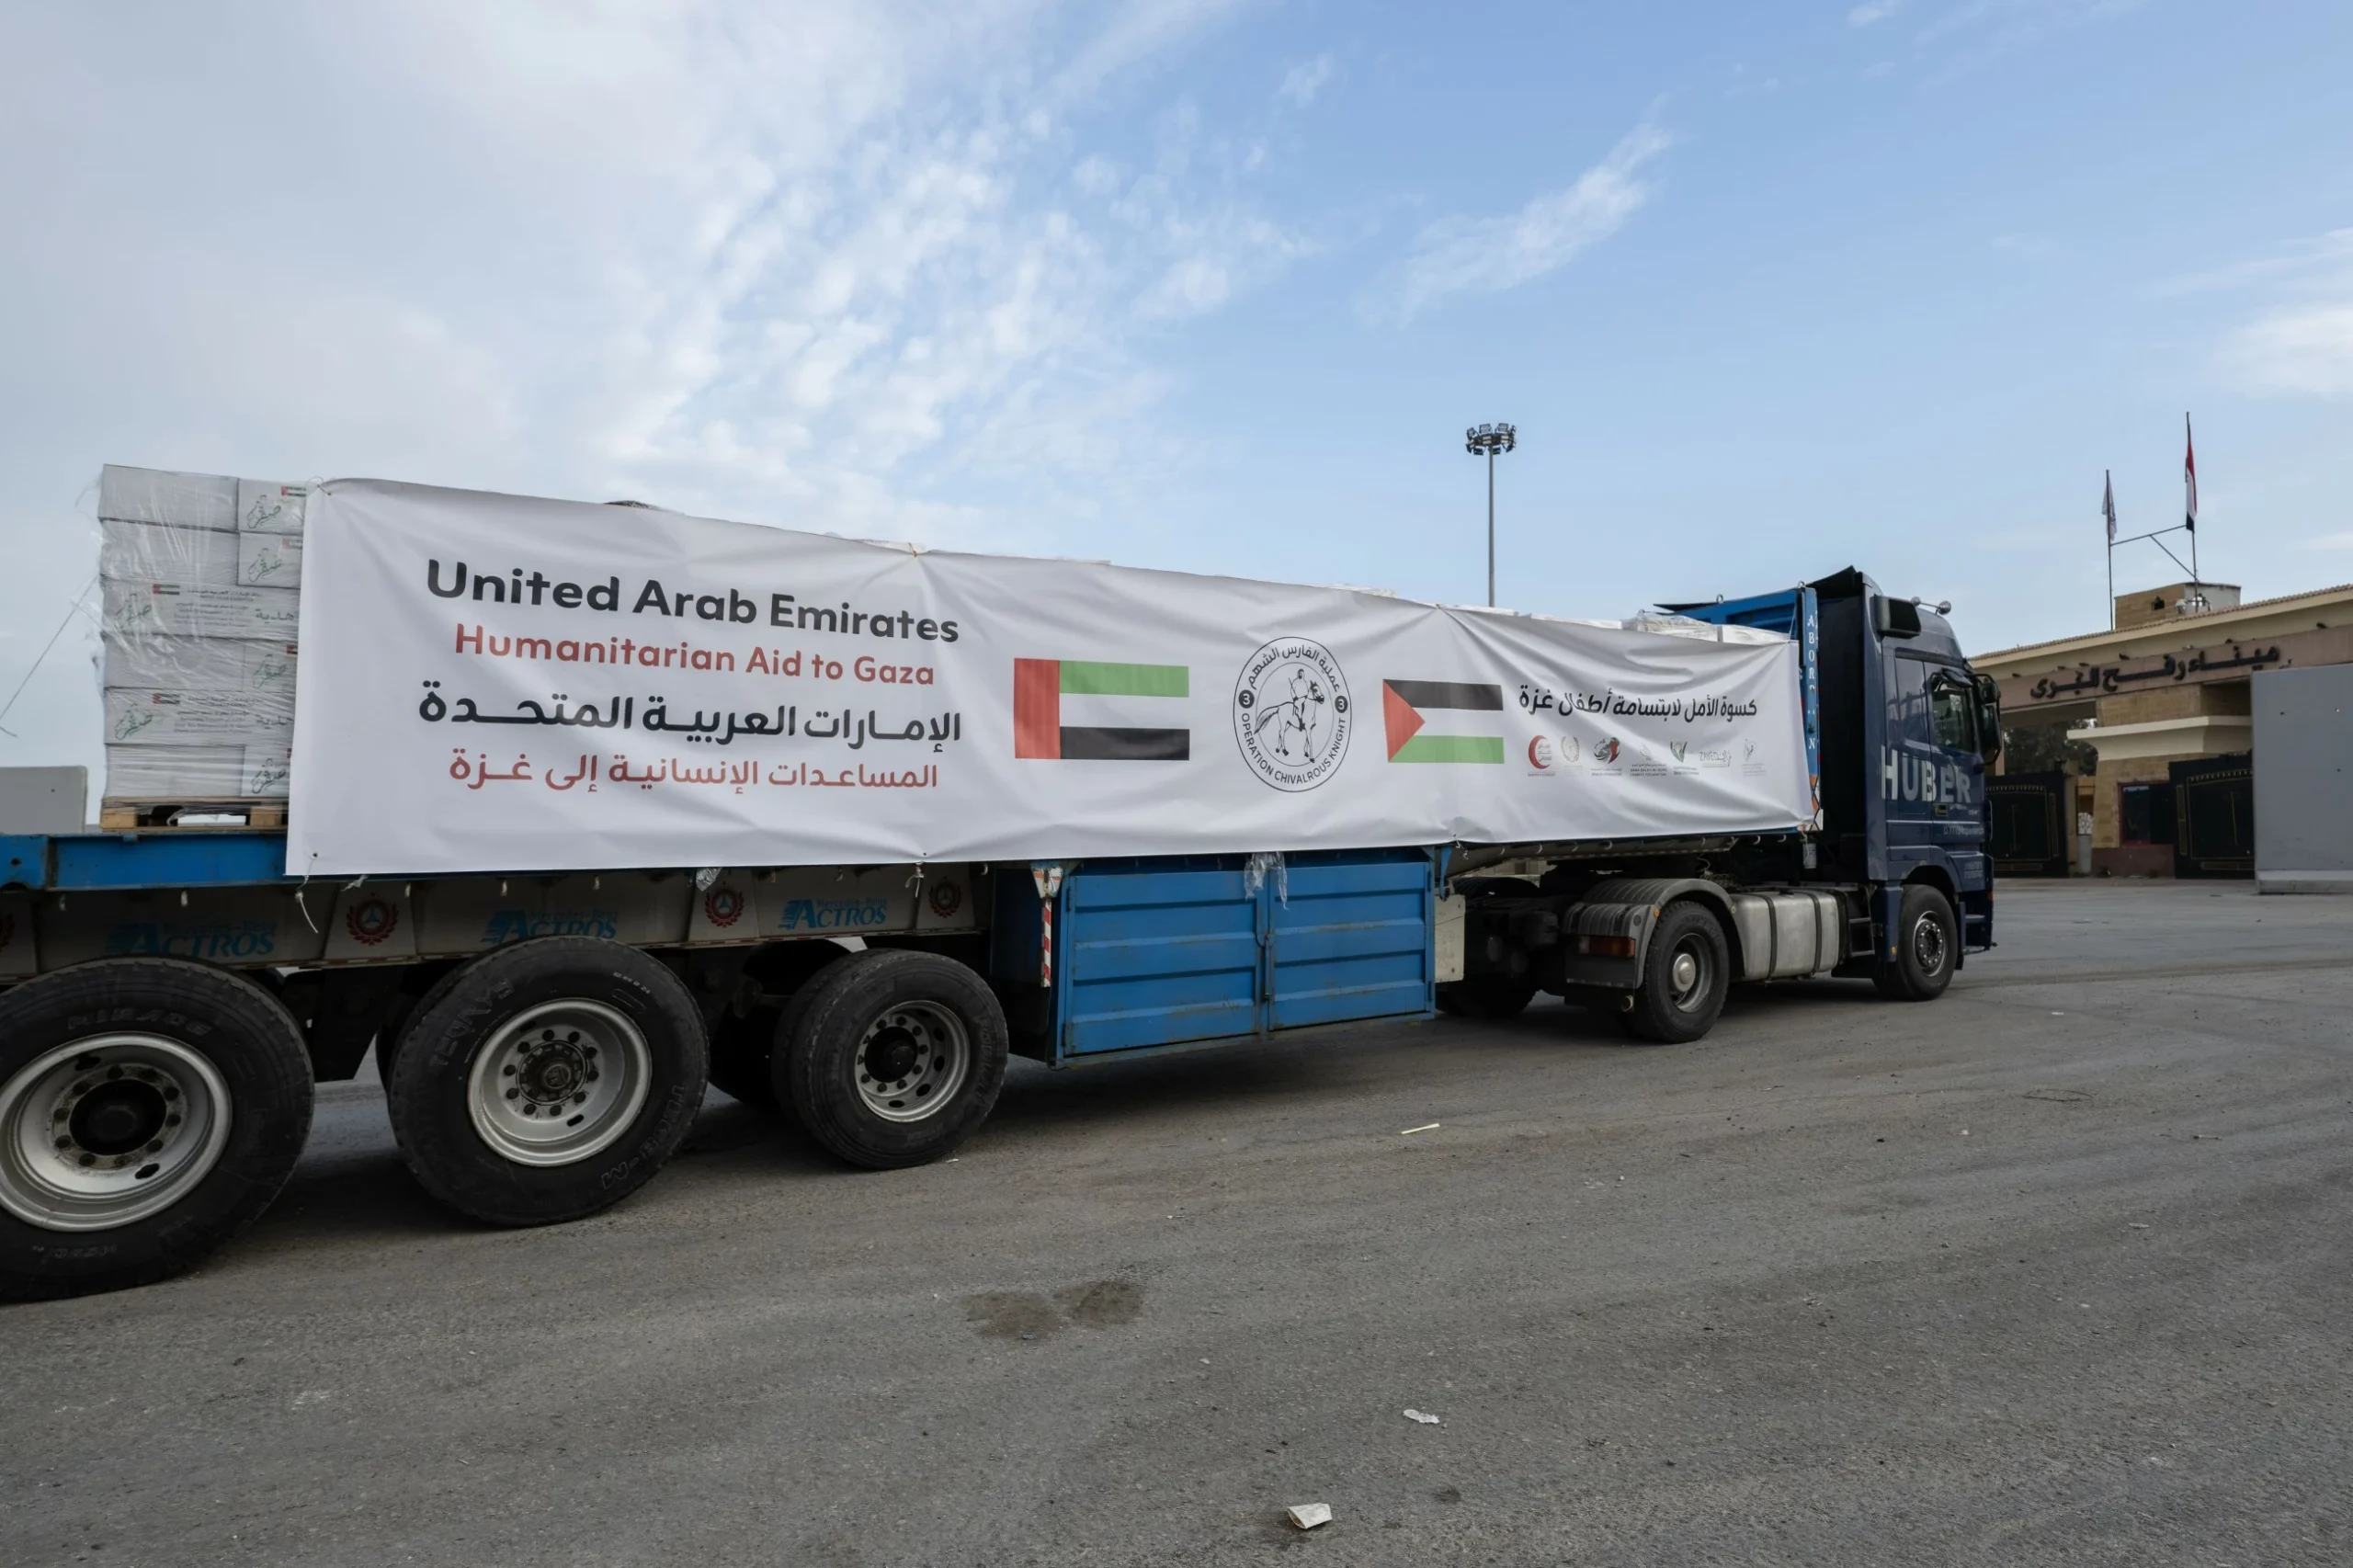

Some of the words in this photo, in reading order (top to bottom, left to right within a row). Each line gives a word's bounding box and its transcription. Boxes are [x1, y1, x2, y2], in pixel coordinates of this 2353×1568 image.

[427, 559, 620, 612] United
[632, 580, 756, 624] Arab
[770, 593, 959, 642] Emirates
[456, 624, 734, 671] Humanitarian
[746, 647, 801, 676] Aid
[812, 654, 843, 679] to
[854, 656, 933, 685] Gaza
[1247, 647, 1279, 690] الشهم
[1281, 645, 1320, 663] الفارس
[2102, 653, 2186, 691] رفح
[2188, 645, 2279, 673] ميناء
[1319, 656, 1340, 692] عملية
[419, 680, 633, 729] المتحدة
[1519, 683, 1553, 715] غزة
[1558, 687, 1612, 717] أطفال
[1612, 696, 1681, 722] لابتسامة
[1684, 695, 1719, 723] الأمل
[1721, 696, 1756, 722] كسوة
[642, 696, 796, 745] العربية
[804, 710, 961, 753] الإمارات
[1242, 713, 1273, 776] OPERATION
[1275, 760, 1332, 784] CHIVALROUS
[1330, 718, 1346, 760] KNIGHT
[449, 748, 532, 790] غزة
[545, 755, 597, 792] إلى
[608, 755, 757, 794] الإنسانية
[768, 763, 937, 788] المساعدات
[1881, 744, 1972, 802] HUBER
